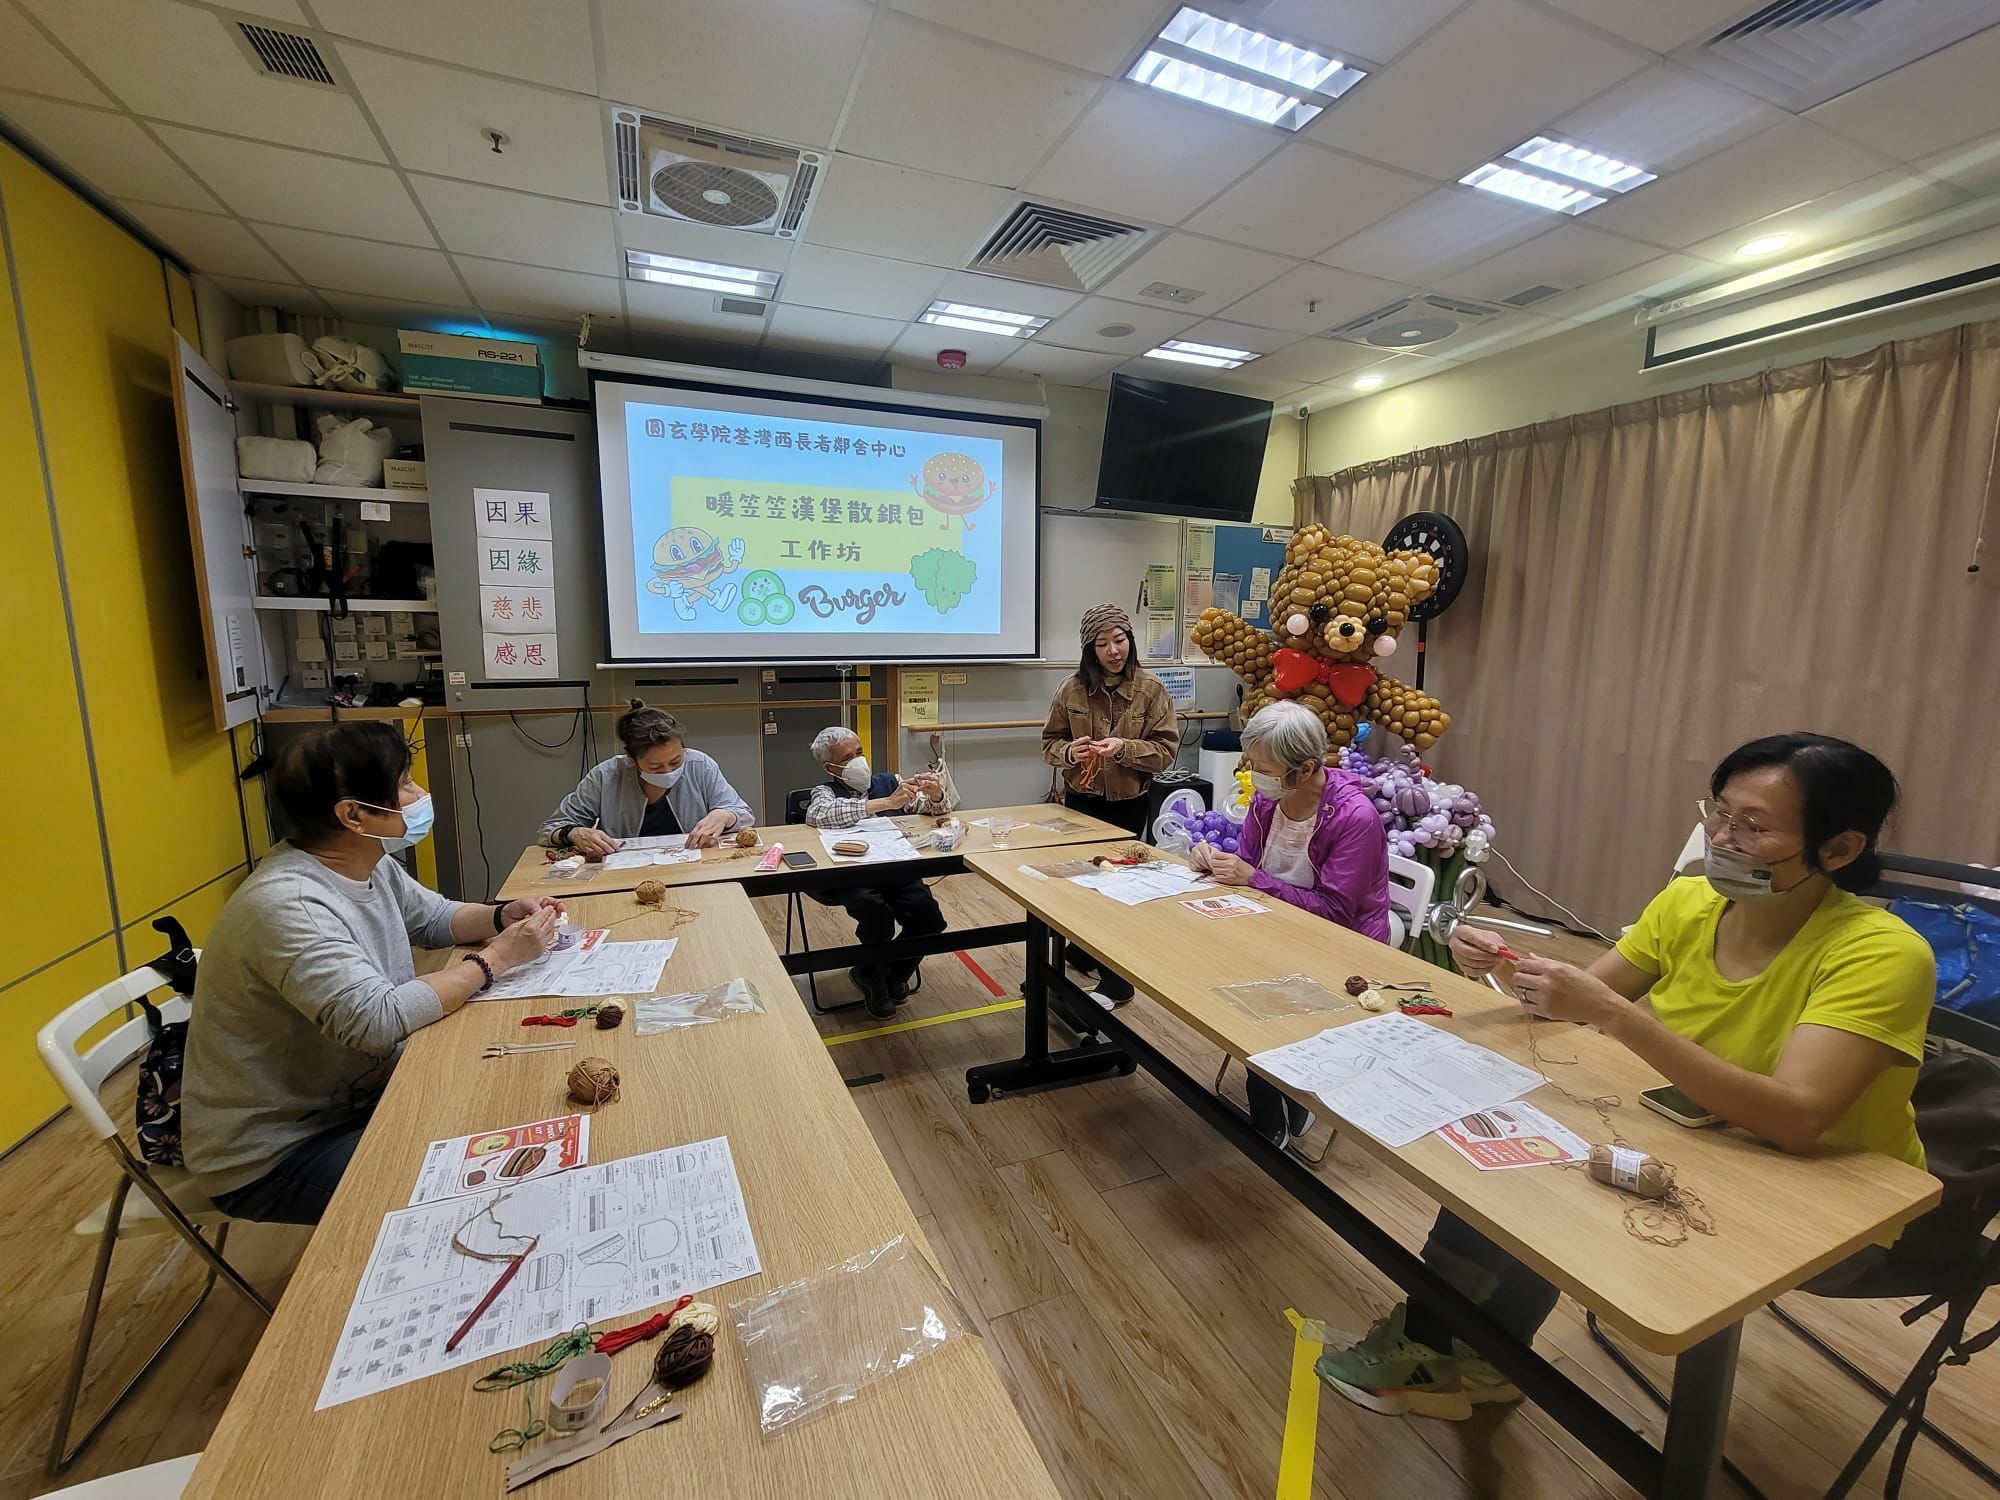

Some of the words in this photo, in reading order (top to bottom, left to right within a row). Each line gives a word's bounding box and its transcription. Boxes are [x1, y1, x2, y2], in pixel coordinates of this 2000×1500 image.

[477, 349, 524, 362] RS-221
[644, 417, 907, 459] 圓玄學院荃灣西長者鄰舍中心
[485, 499, 541, 526] 因果
[705, 490, 926, 527] 暖笠笠漢堡散銀包
[489, 548, 543, 575] 因緣
[780, 539, 863, 563] 工作坊
[491, 595, 544, 621] 慈悲
[798, 582, 907, 626] Burger
[493, 642, 547, 667] 感恩
